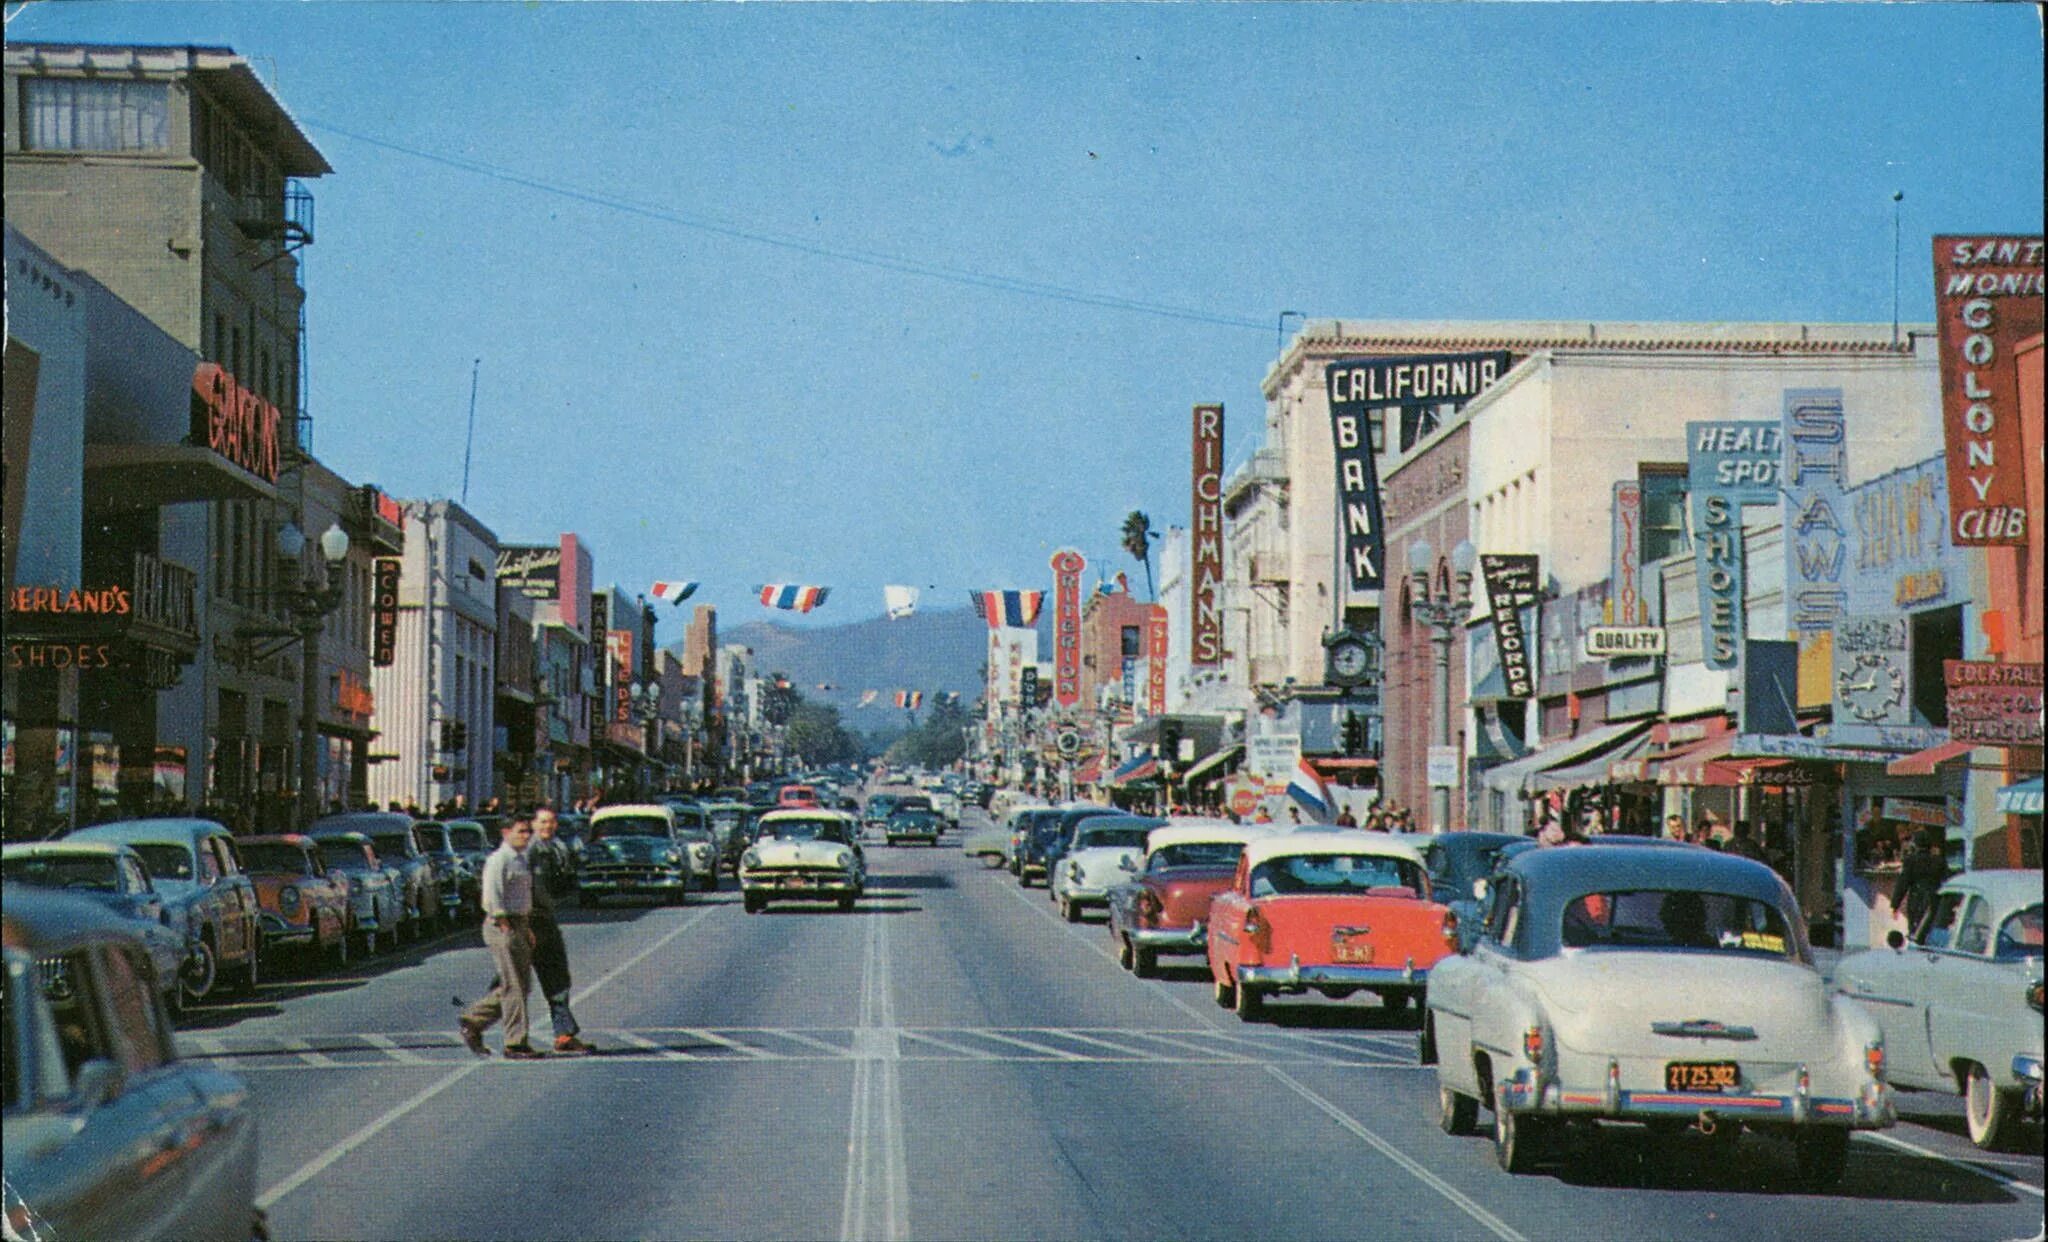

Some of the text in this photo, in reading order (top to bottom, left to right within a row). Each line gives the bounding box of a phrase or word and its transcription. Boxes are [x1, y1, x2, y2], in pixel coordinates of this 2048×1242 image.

[1952, 242, 2043, 263] SANT
[1332, 358, 1497, 403] CALIFORNIA
[1962, 298, 1995, 501] COLONY
[1336, 415, 1377, 579] BANK
[1958, 509, 2026, 539] CLUB
[1621, 511, 1637, 624] VICTOR
[1705, 496, 1734, 663] SHOES
[9, 644, 110, 669] SHOES
[1060, 553, 1078, 695] CRITERION
[1153, 625, 1164, 715] SINGER
[1494, 593, 1530, 696] RECORDS
[1953, 664, 2043, 683] COCKTAIL
